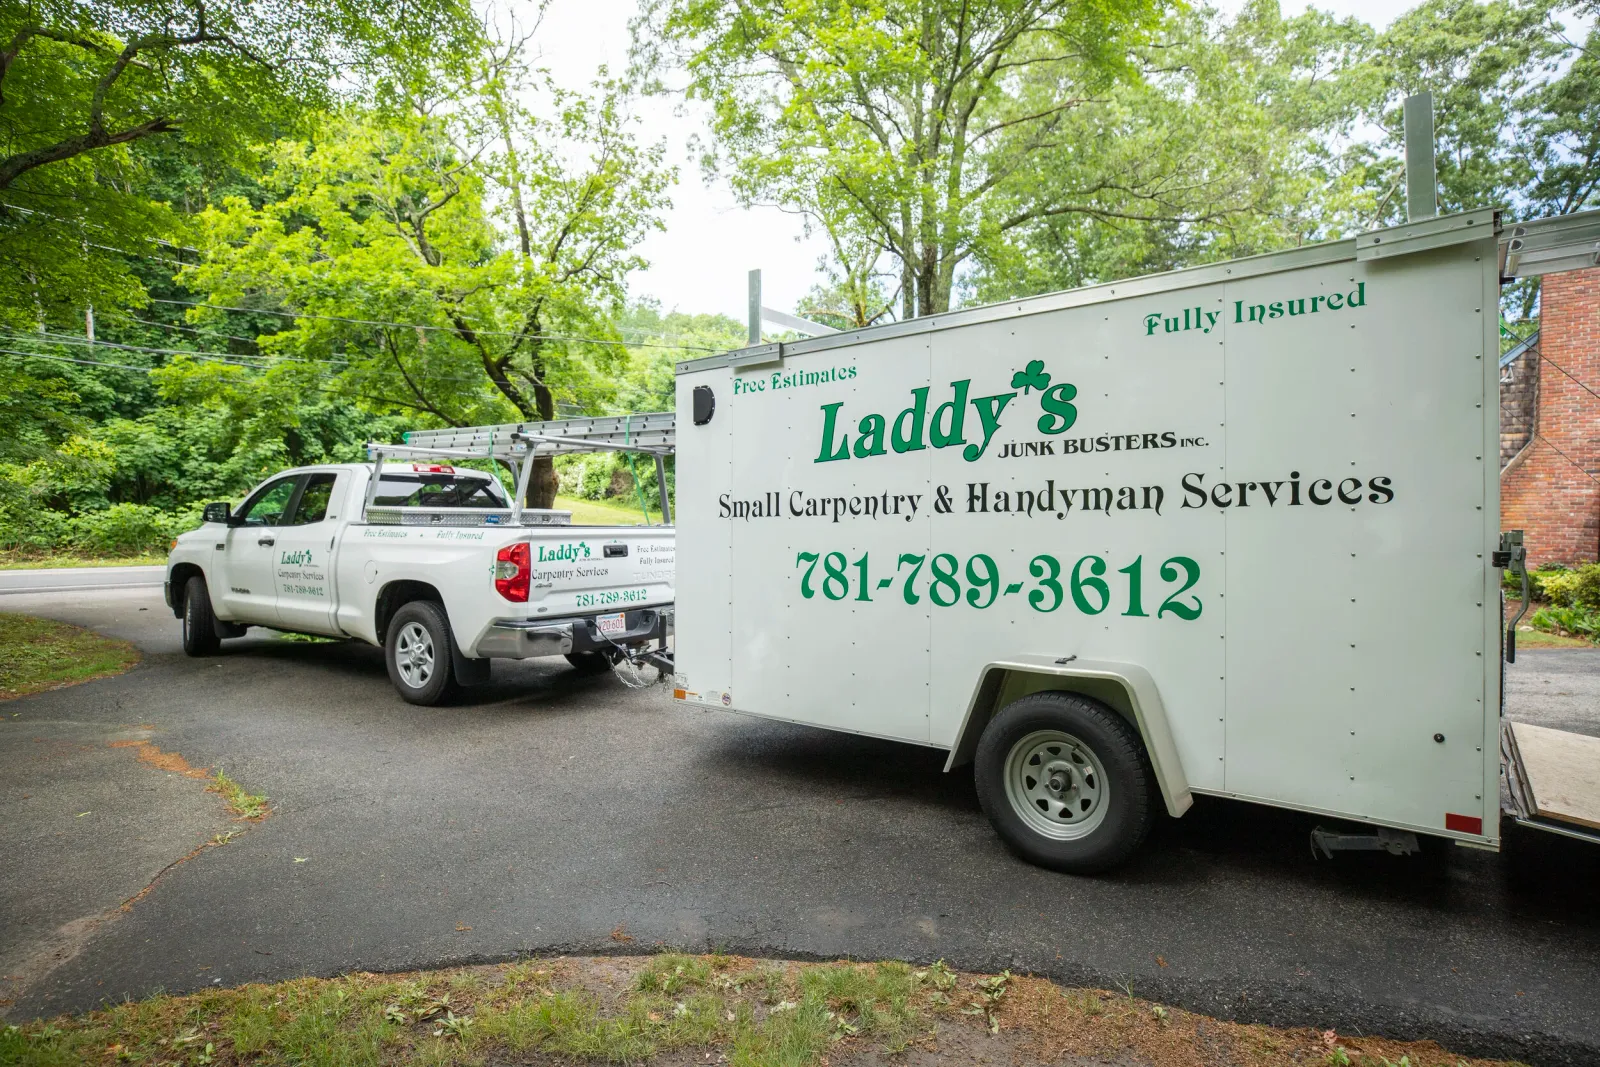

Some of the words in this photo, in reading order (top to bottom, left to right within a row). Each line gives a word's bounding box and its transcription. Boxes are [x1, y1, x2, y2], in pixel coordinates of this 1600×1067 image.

[1145, 305, 1220, 336] Fully
[1234, 281, 1366, 325] Insured
[734, 376, 766, 395] Free
[772, 364, 858, 390] Estimates
[813, 360, 1078, 464] Laddy's
[998, 439, 1055, 459] JUNK
[1063, 431, 1177, 455] BUSTERS
[1179, 436, 1210, 449] INC.
[718, 491, 781, 522] Small
[789, 490, 923, 523] Carpentry
[933, 484, 954, 514] &
[966, 479, 1164, 521] Handyman
[1180, 471, 1395, 509] Services
[280, 549, 313, 568] Laddy's
[538, 541, 591, 563] Laddy's
[639, 556, 653, 566] Fully
[302, 570, 325, 581] Services
[531, 568, 574, 582] Carpentry
[576, 566, 609, 578] Services
[796, 551, 1204, 622] 781-789-3612
[575, 588, 647, 608] 781-789-3612
